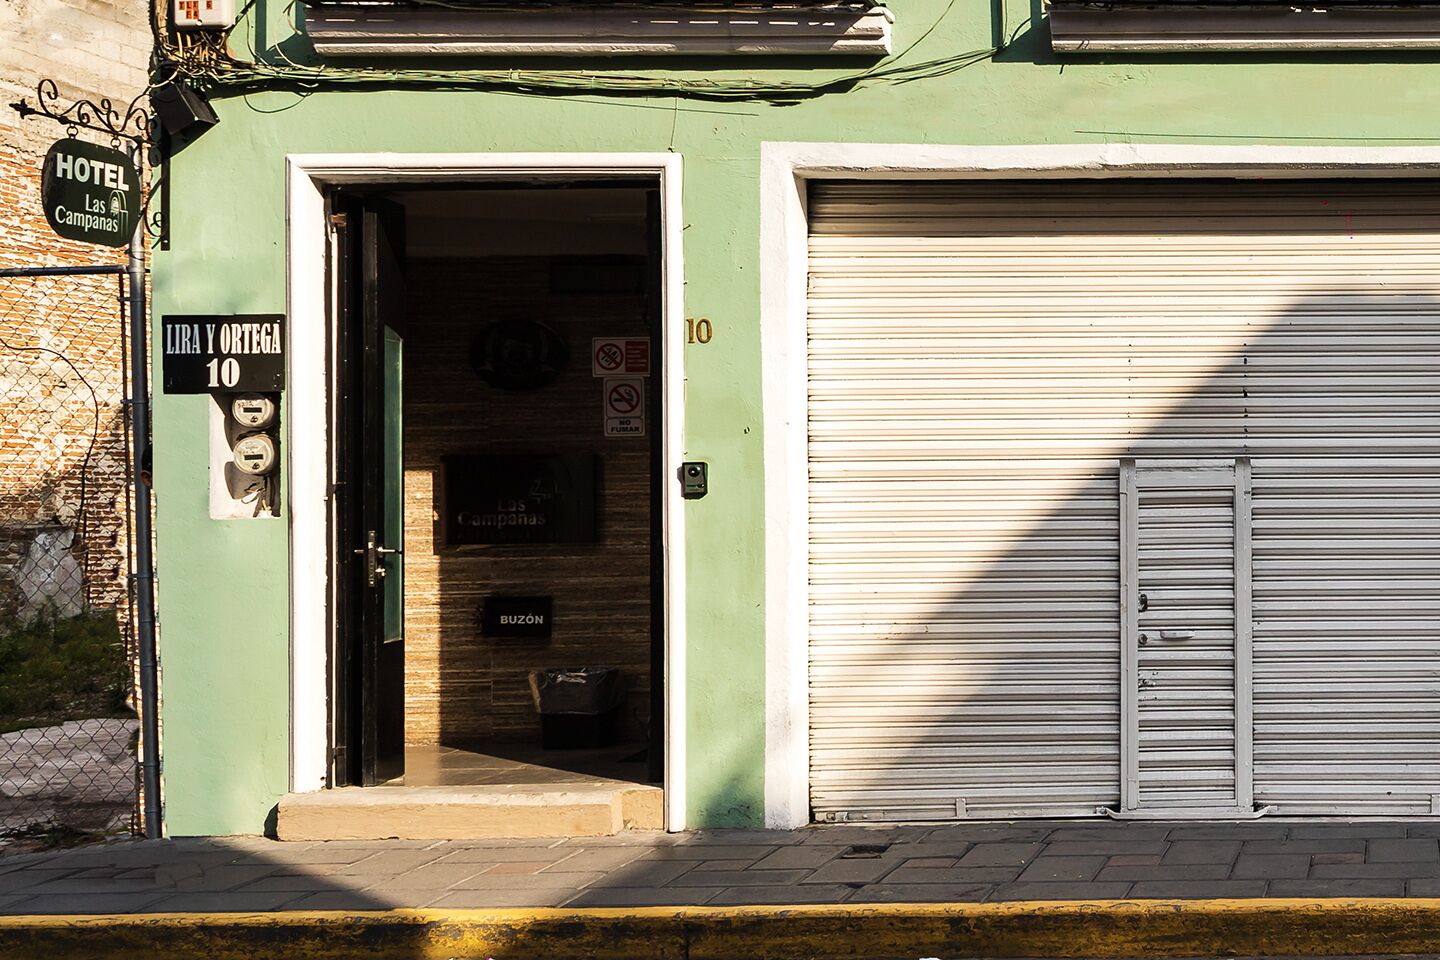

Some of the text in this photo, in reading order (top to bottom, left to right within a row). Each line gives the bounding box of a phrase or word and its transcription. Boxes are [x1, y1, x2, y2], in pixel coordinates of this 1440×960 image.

[56, 153, 129, 191] HOTEL
[85, 193, 106, 214] Las
[55, 205, 119, 232] Campanas
[166, 323, 282, 354] LIRA Y ORTEGA
[686, 318, 713, 344] 10
[206, 357, 241, 388] 10
[497, 497, 527, 513] Las
[457, 511, 547, 529] Campanas
[499, 612, 544, 625] BUZÓN
